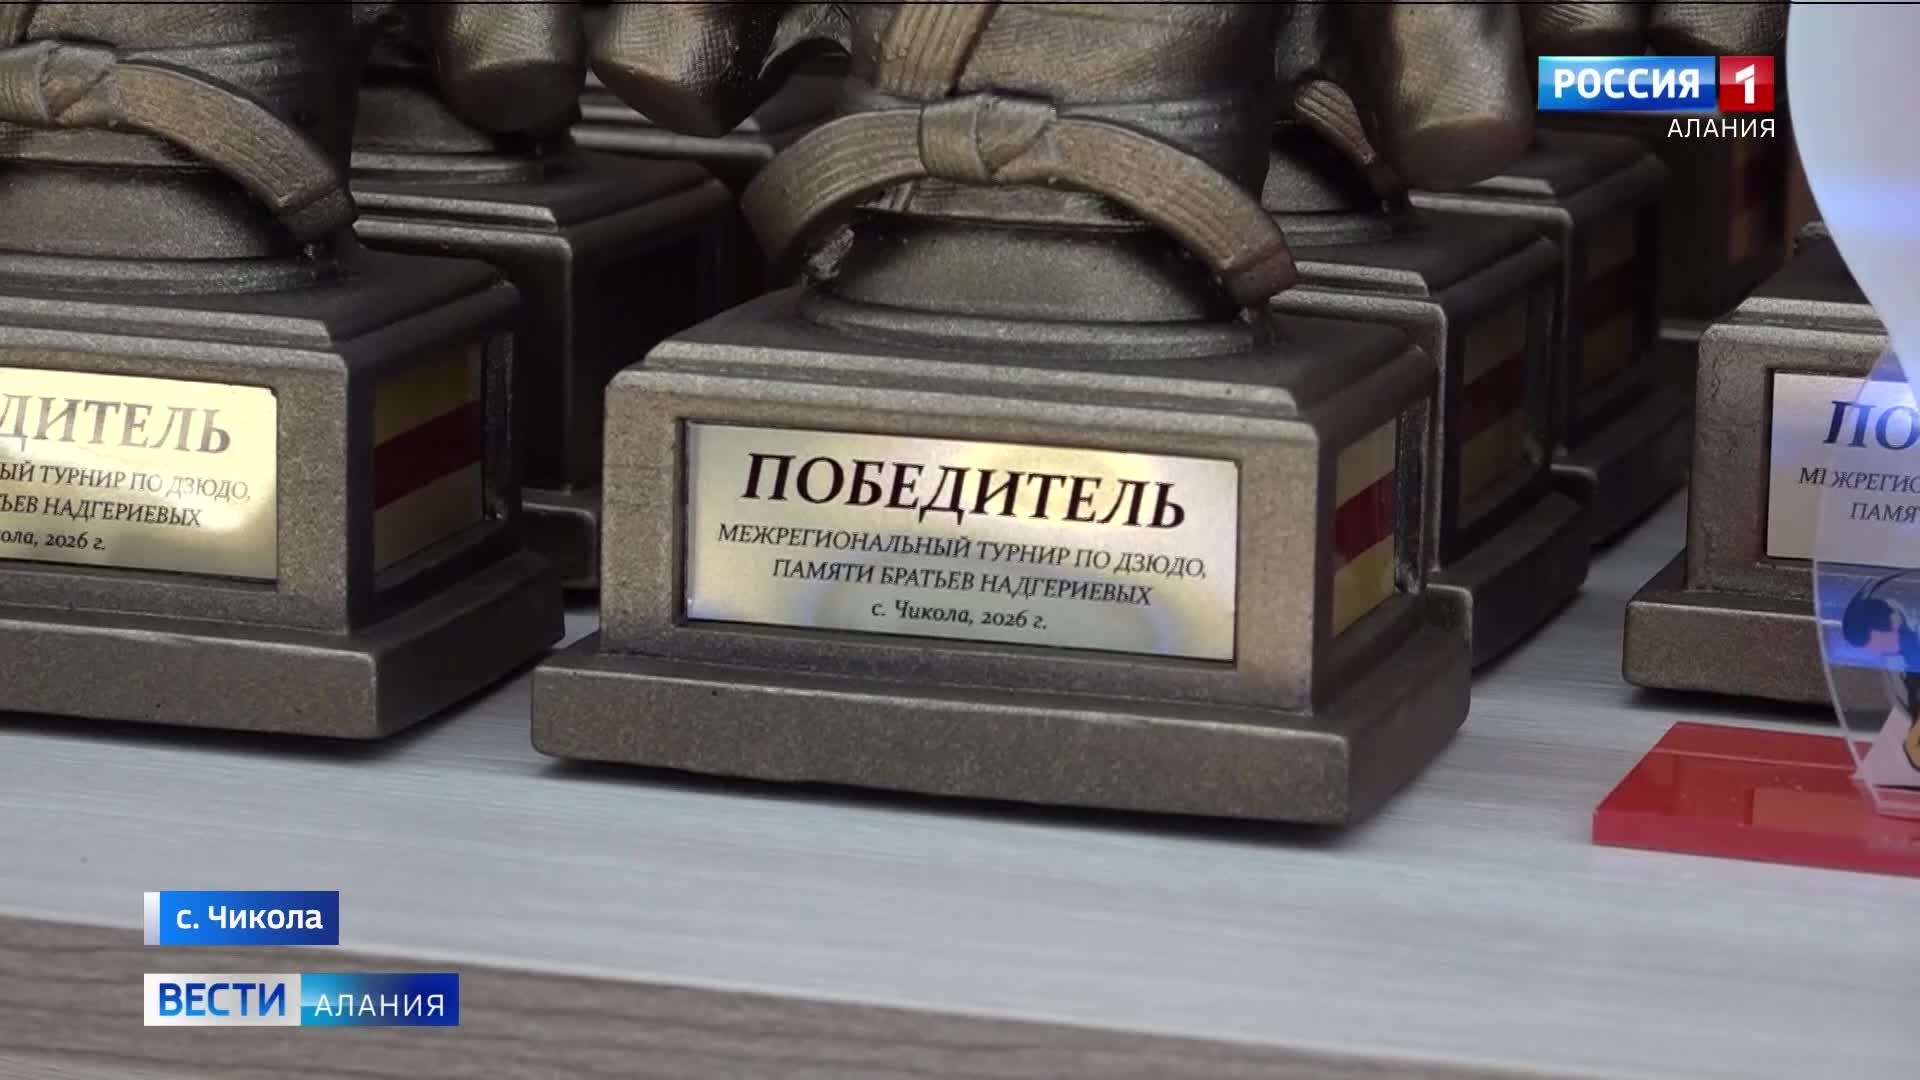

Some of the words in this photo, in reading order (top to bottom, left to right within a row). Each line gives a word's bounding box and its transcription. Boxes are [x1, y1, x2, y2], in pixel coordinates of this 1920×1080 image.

[39, 464, 126, 490] ТУРНИР
[129, 472, 163, 492] ПО
[166, 476, 251, 503] ДЗЮДО,
[741, 452, 1186, 529] ПОБЕДИТЕЛЬ
[0, 493, 39, 514] ЬЕВ
[42, 496, 203, 528] НАДГЕРИЕВЫХ
[1849, 502, 1920, 523] ПАМЯ
[44, 530, 88, 549] 2026
[717, 523, 972, 559] МЕЖРЕГИОНАЛЬНЫЙ
[976, 540, 1071, 567] ТУРНИР
[1074, 548, 1111, 570] ПО
[1114, 552, 1207, 579] ДЗЮДО,
[772, 558, 875, 585] ПАМЯТИ
[880, 566, 975, 591] БРАТЬЕВ
[979, 574, 1155, 606] НАДГЕРИЕВЫХ
[871, 602, 887, 618] с.
[895, 599, 974, 626] Чикола,
[980, 608, 1028, 629] 2026
[1033, 615, 1047, 630] г.
